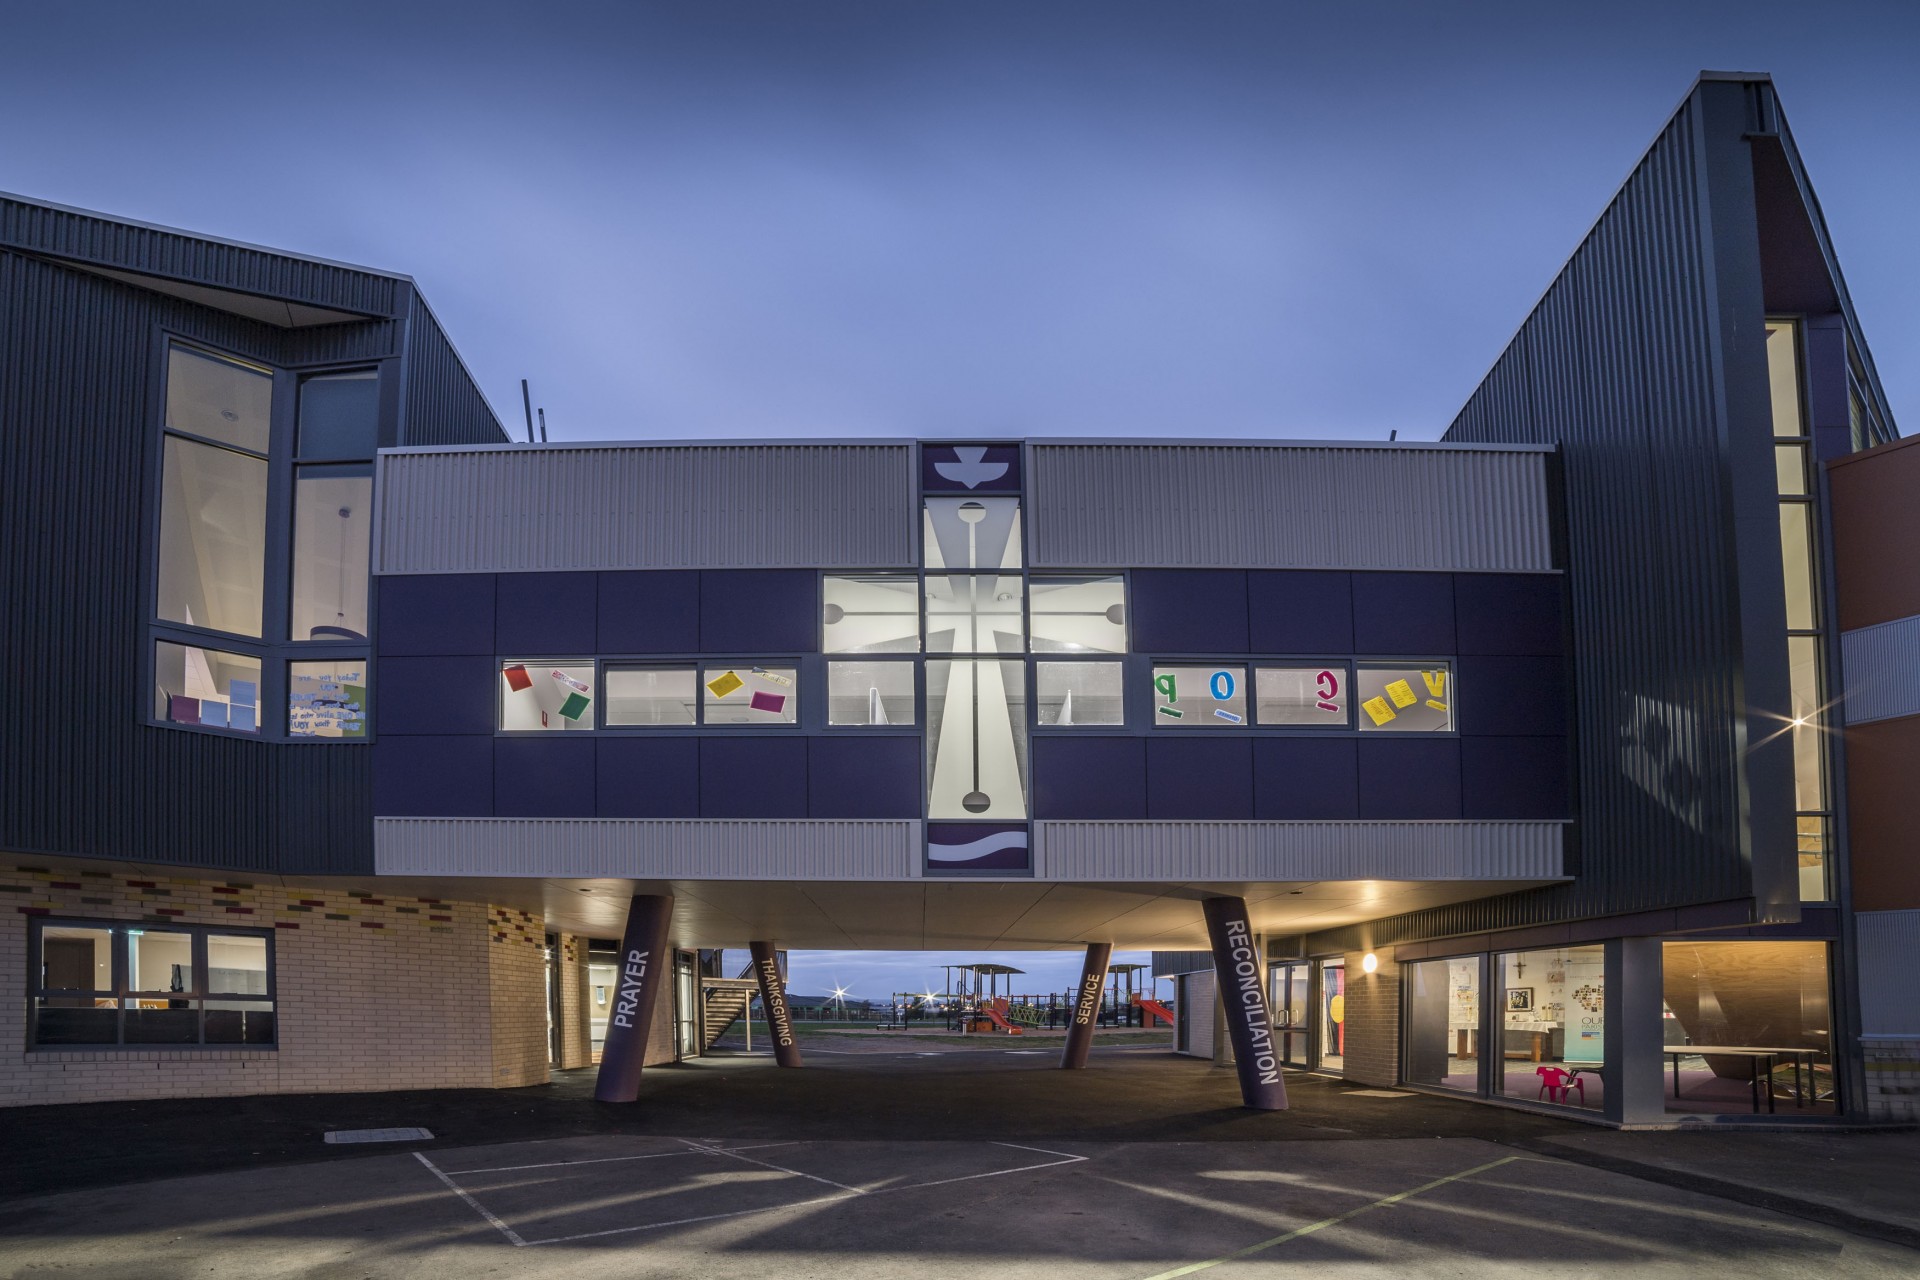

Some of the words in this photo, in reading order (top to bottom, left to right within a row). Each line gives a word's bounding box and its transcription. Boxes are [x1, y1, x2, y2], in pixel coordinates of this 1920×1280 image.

[615, 949, 649, 1028] PRAYER
[761, 957, 792, 1047] THANKSGIVING
[1076, 973, 1100, 1025] SERVICE
[1225, 919, 1279, 1085] RECONCILIATION
